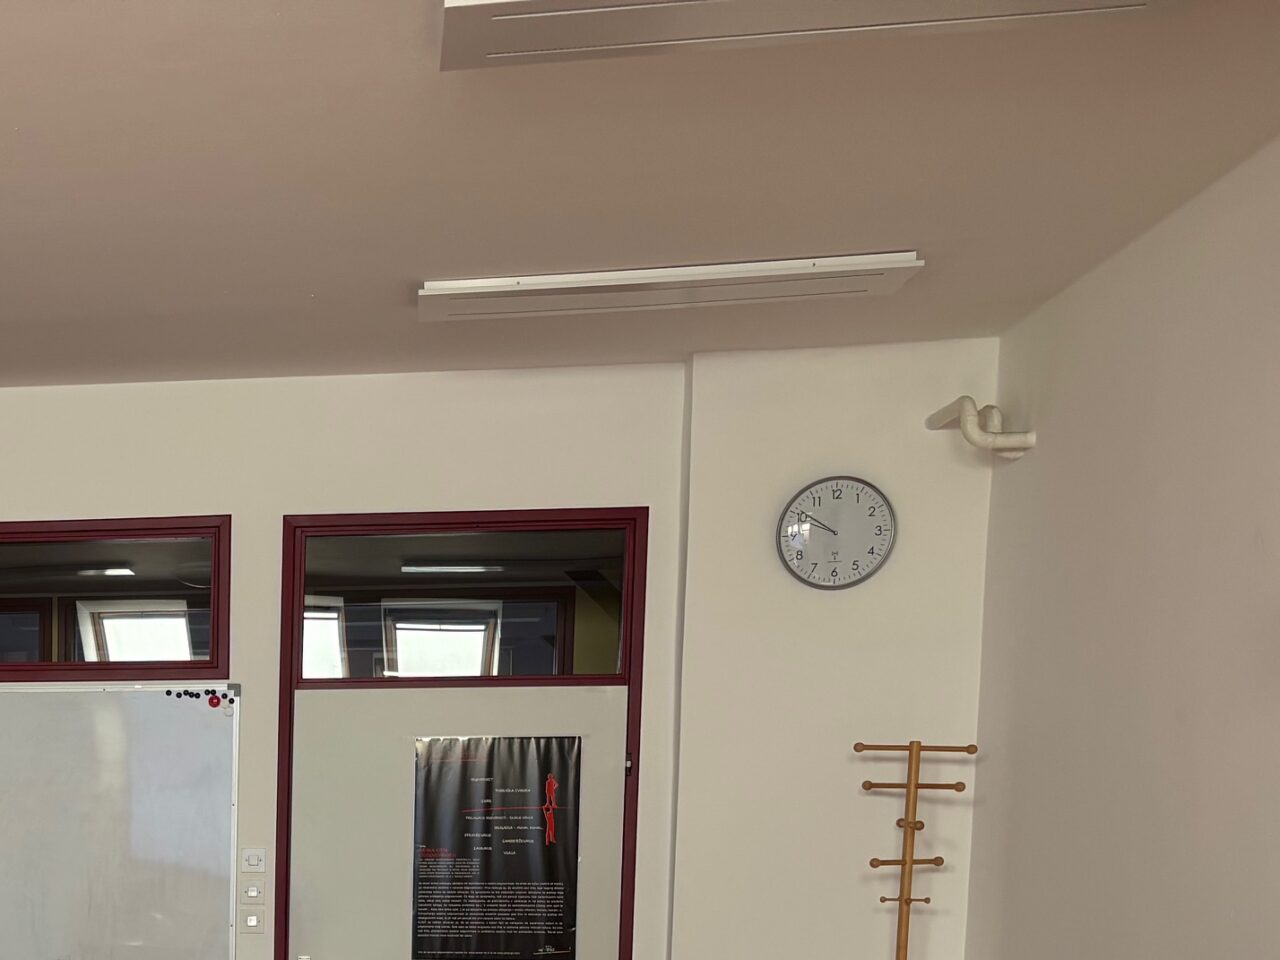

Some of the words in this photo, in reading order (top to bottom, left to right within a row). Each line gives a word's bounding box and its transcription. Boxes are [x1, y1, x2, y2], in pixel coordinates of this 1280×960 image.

[832, 488, 843, 500] 12
[856, 493, 860, 504] 1
[812, 496, 821, 507] 11
[868, 505, 876, 517] 2
[796, 511, 808, 523] 10
[875, 525, 882, 536] 3
[795, 550, 803, 561] 8
[867, 546, 875, 556] 4
[810, 562, 818, 576] 7
[852, 560, 859, 571] 5
[831, 567, 838, 578] 6
